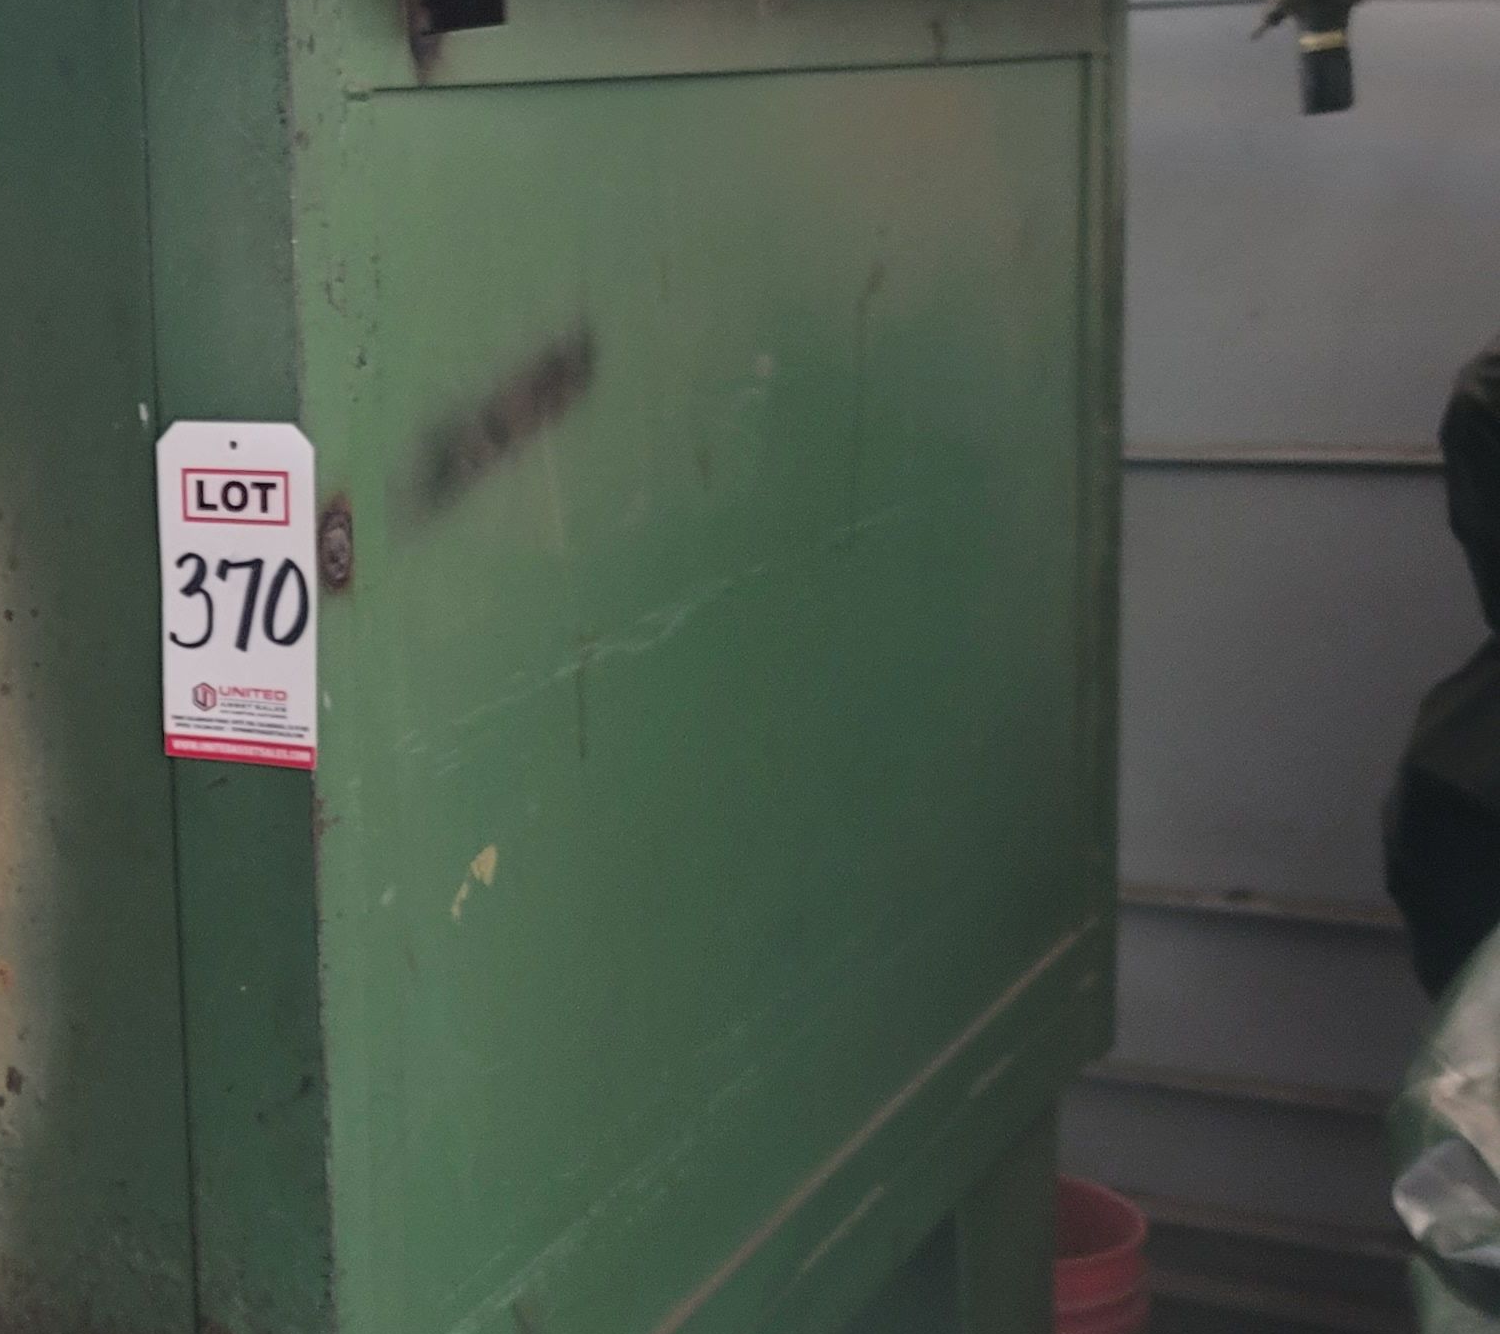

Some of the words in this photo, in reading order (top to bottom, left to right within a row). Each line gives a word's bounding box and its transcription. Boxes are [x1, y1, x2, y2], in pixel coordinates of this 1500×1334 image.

[196, 480, 277, 513] LOT
[169, 552, 310, 652] 370
[219, 686, 287, 701] UNITED
